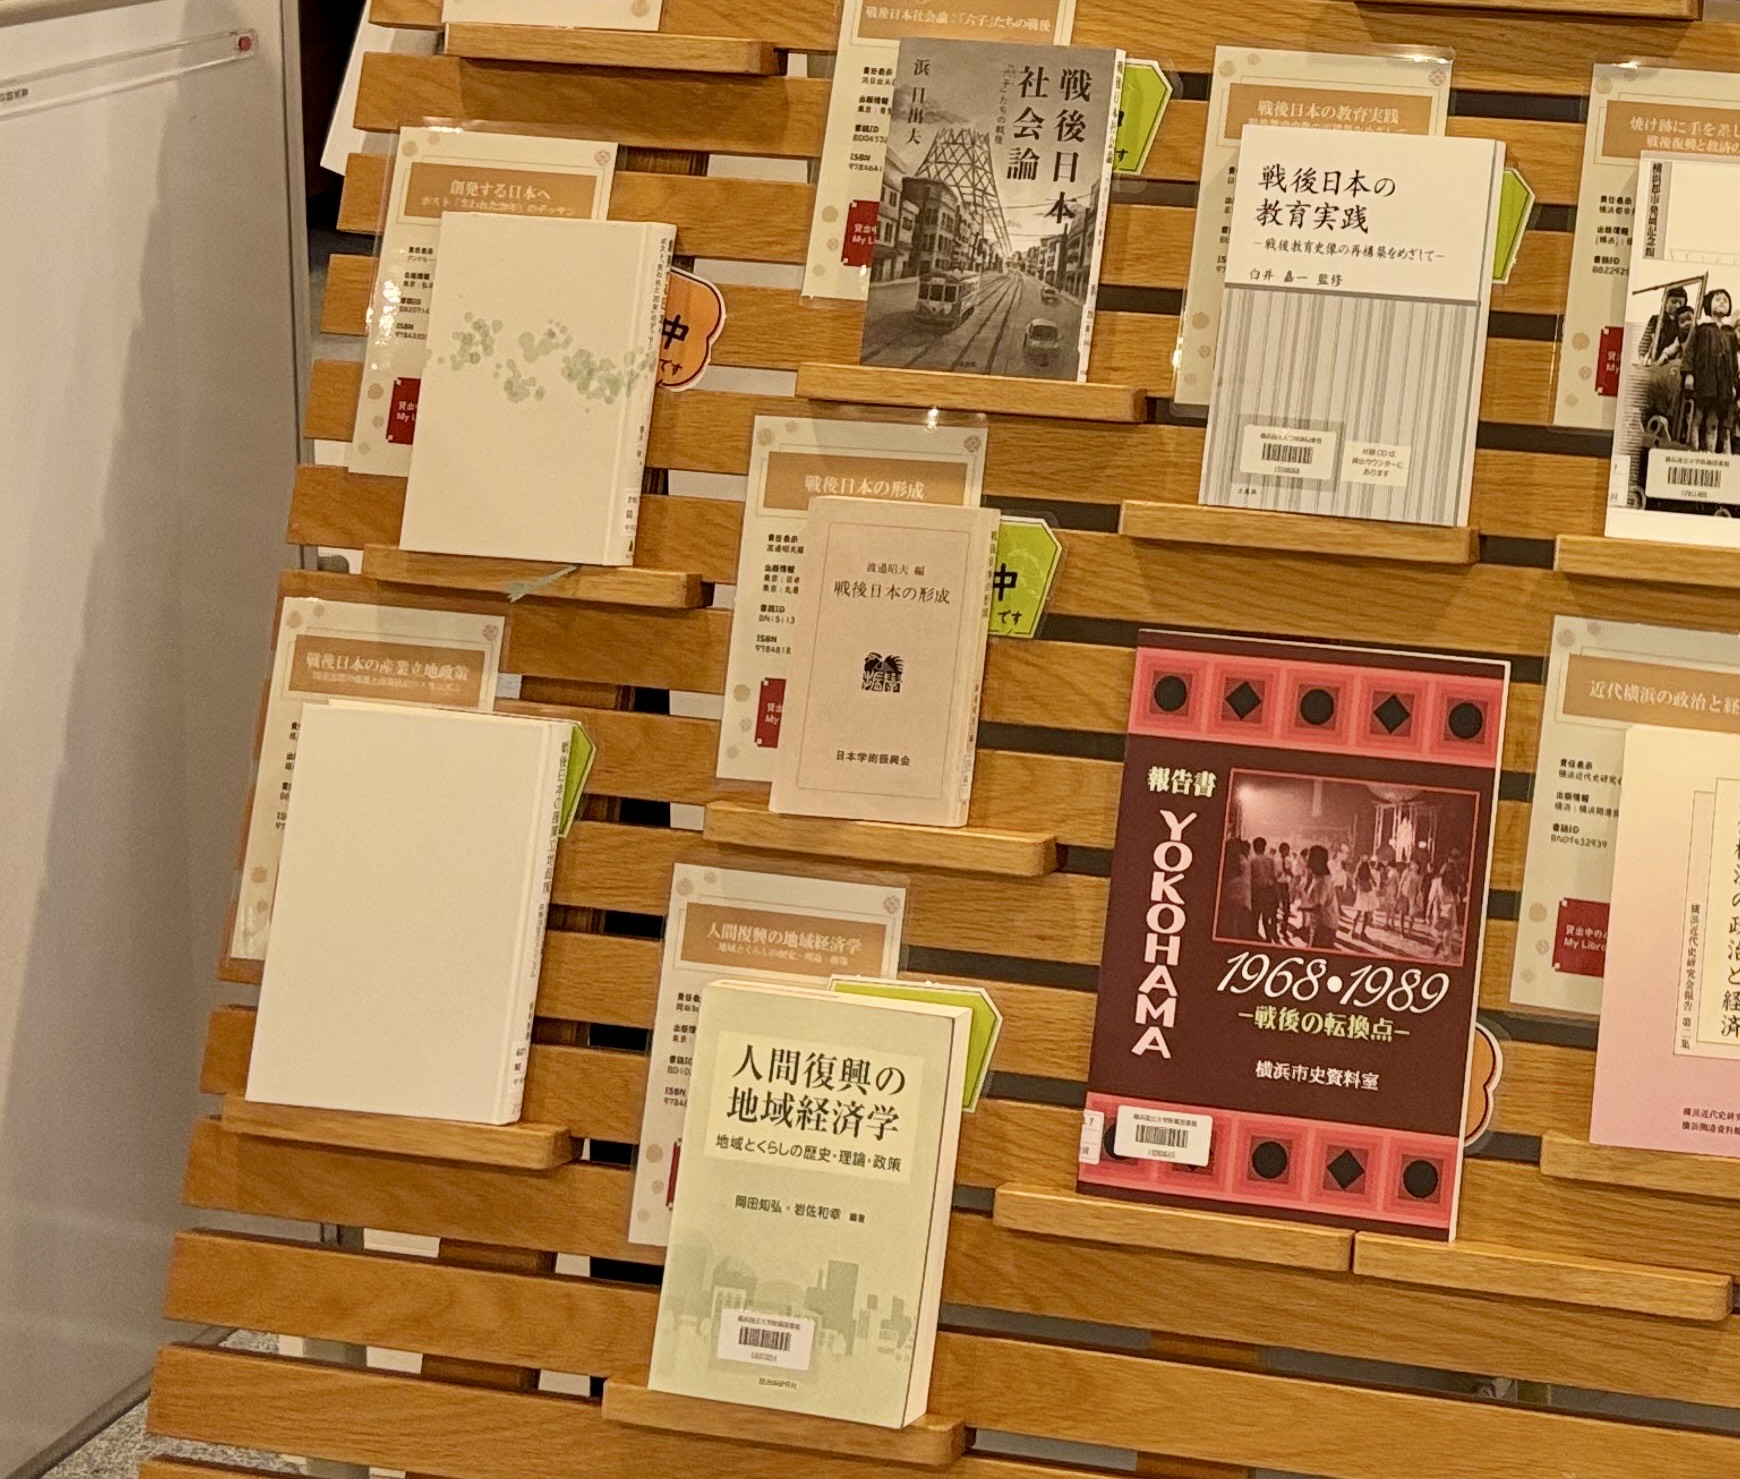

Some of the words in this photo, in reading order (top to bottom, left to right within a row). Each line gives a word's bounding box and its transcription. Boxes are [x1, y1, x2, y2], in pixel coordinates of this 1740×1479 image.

[913, 58, 930, 76] 浜
[1007, 65, 1051, 182] 社会論
[1257, 100, 1400, 126] 戦後日本の教育実践
[1043, 67, 1094, 226] 戦後日本
[450, 179, 552, 201] 創発する日本へ
[1257, 163, 1397, 198] 戦後日本の
[1254, 197, 1369, 234] 教育実践
[1317, 272, 1344, 288] 監修
[804, 474, 926, 502] 戦後日本の形成
[833, 580, 951, 605] 戦後日本の形成
[997, 609, 1023, 627] です
[306, 651, 469, 682] 戦後日本の産業立地政策
[1146, 765, 1218, 799] 報告書
[706, 921, 864, 955] 人間復興の地域経済学
[1130, 809, 1199, 1061] YOKOHAMA
[732, 1044, 907, 1098] 人間復興の
[1254, 1060, 1381, 1092] 横浜市史資料室
[726, 1086, 901, 1143] 地域経済学
[714, 1132, 902, 1174] 地域とくらしの歴史・理論・政策
